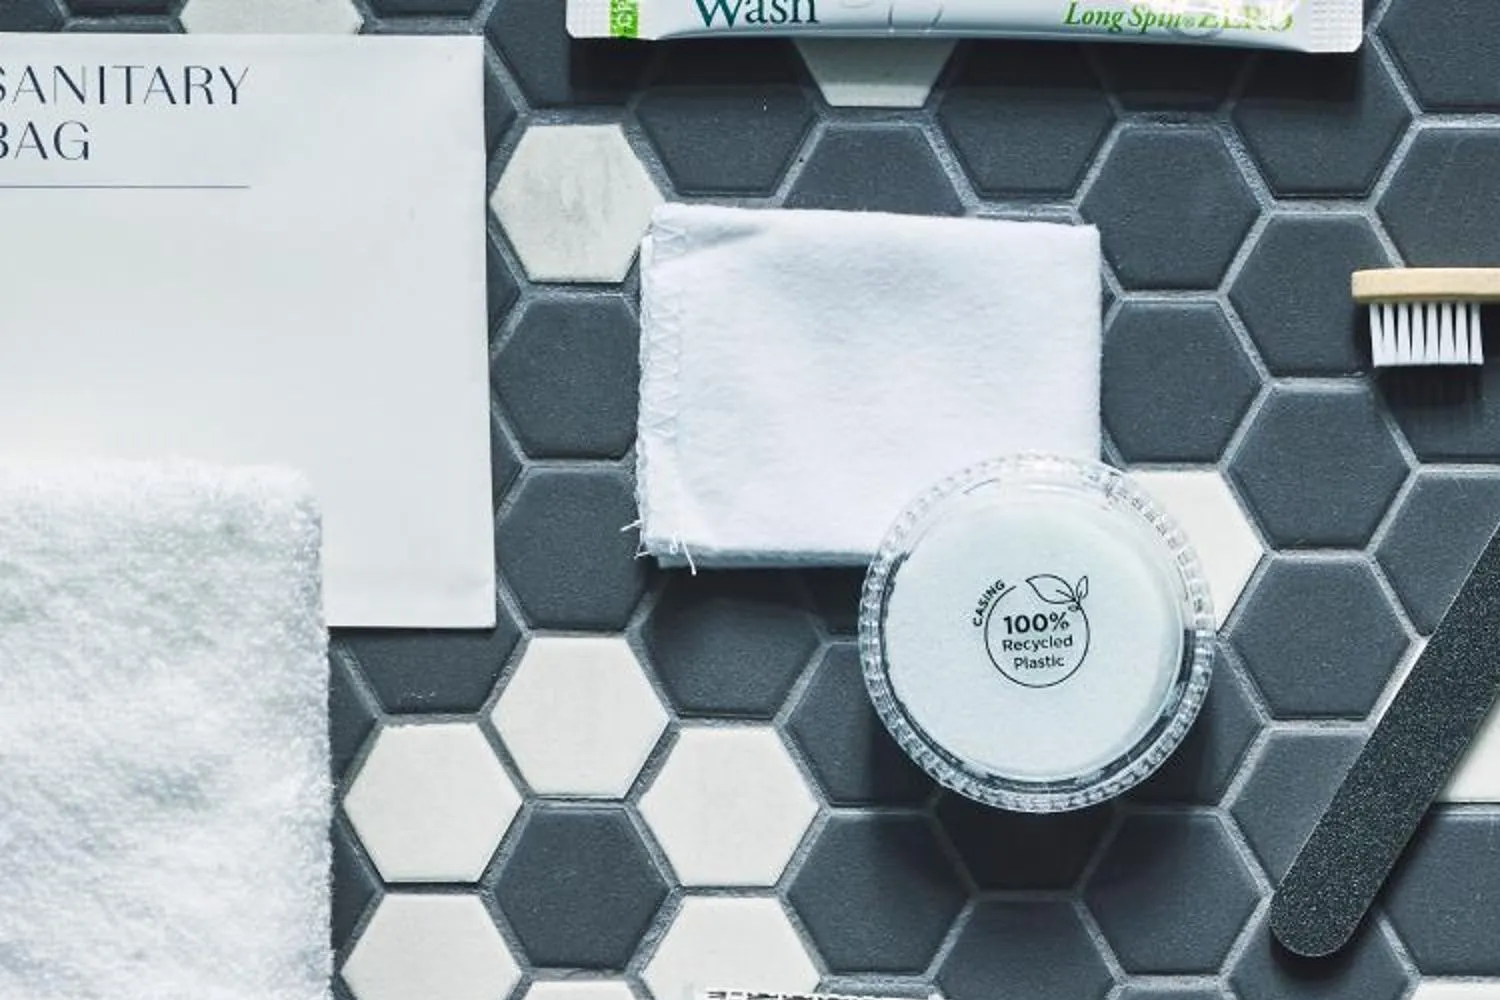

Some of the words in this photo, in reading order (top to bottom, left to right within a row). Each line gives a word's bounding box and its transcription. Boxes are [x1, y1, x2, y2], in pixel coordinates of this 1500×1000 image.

[695, 0, 819, 28] Wash
[1064, 2, 1125, 33] Long
[972, 579, 1006, 627] CASING
[1003, 612, 1070, 635] 100%
[1002, 635, 1073, 652] Recycled
[1013, 654, 1065, 670] Plastic
